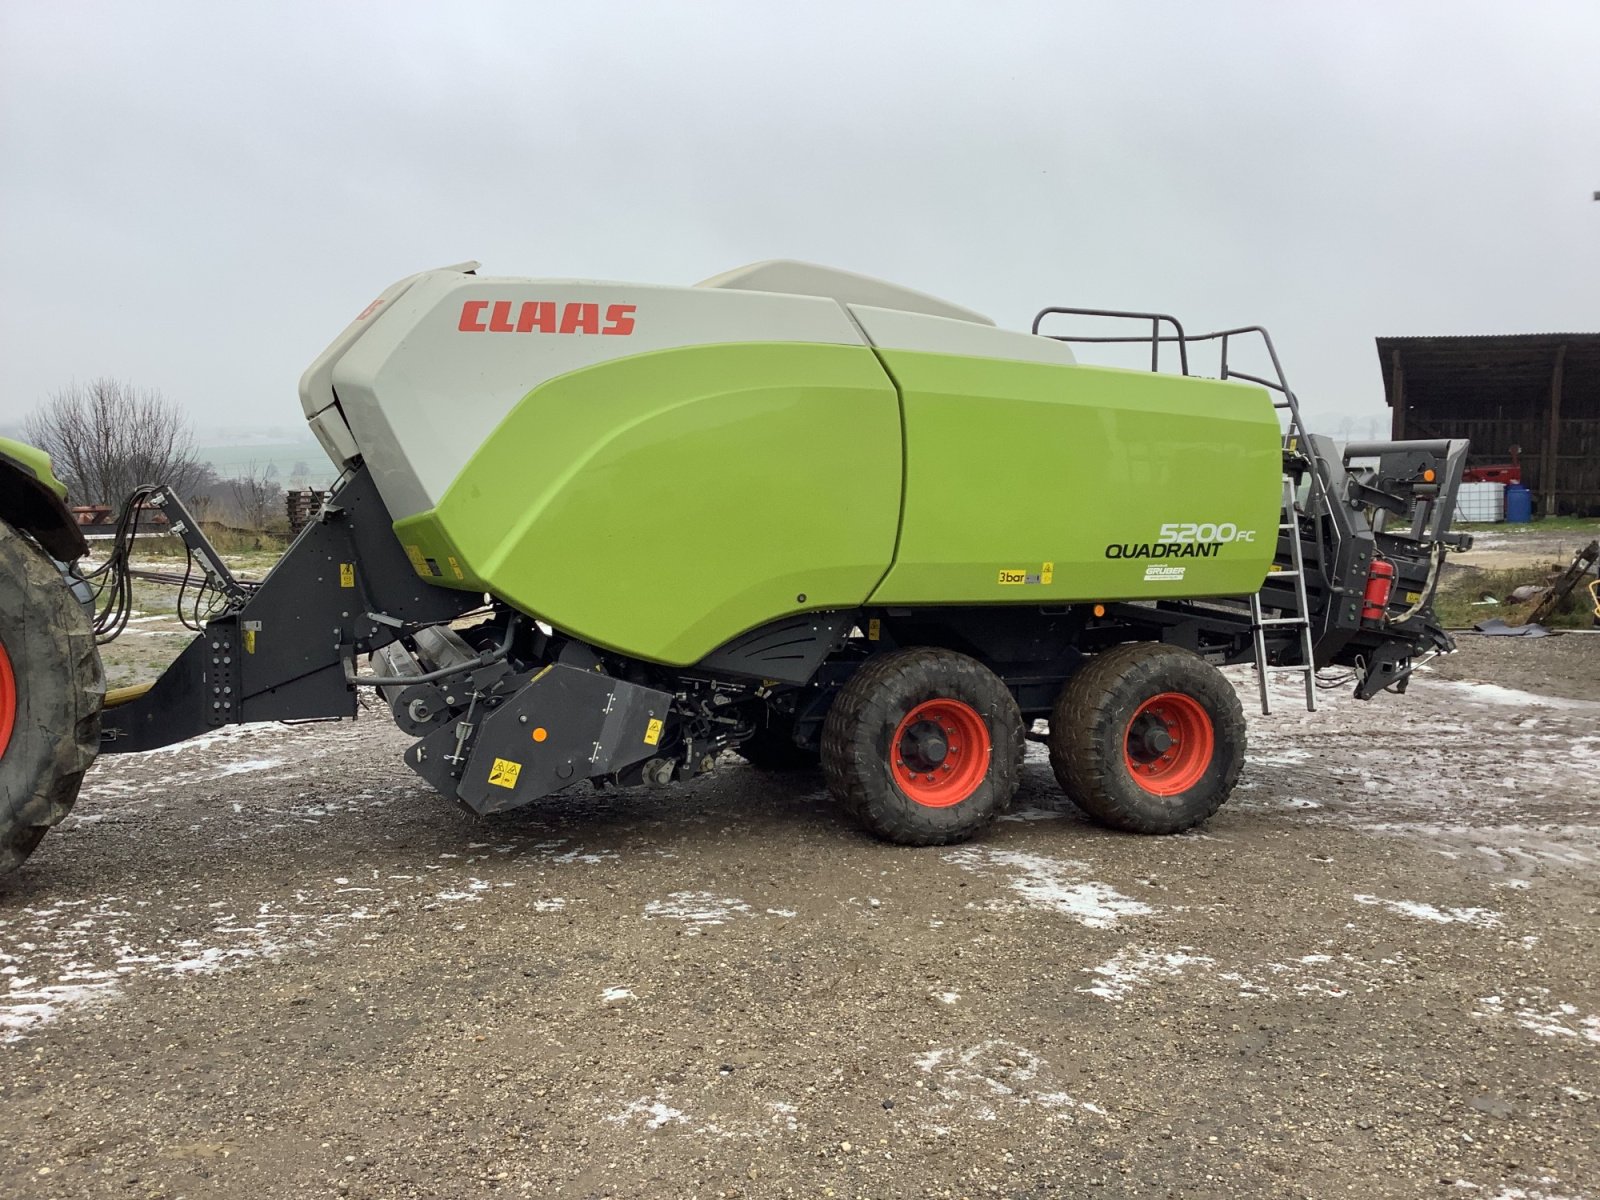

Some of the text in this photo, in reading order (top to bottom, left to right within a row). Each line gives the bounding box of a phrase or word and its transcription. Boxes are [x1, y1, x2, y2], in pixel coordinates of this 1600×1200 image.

[458, 301, 637, 336] CLAAS
[1158, 523, 1237, 544] 5200
[1105, 543, 1224, 559] QUADRANT
[1145, 567, 1186, 575] GRUBER
